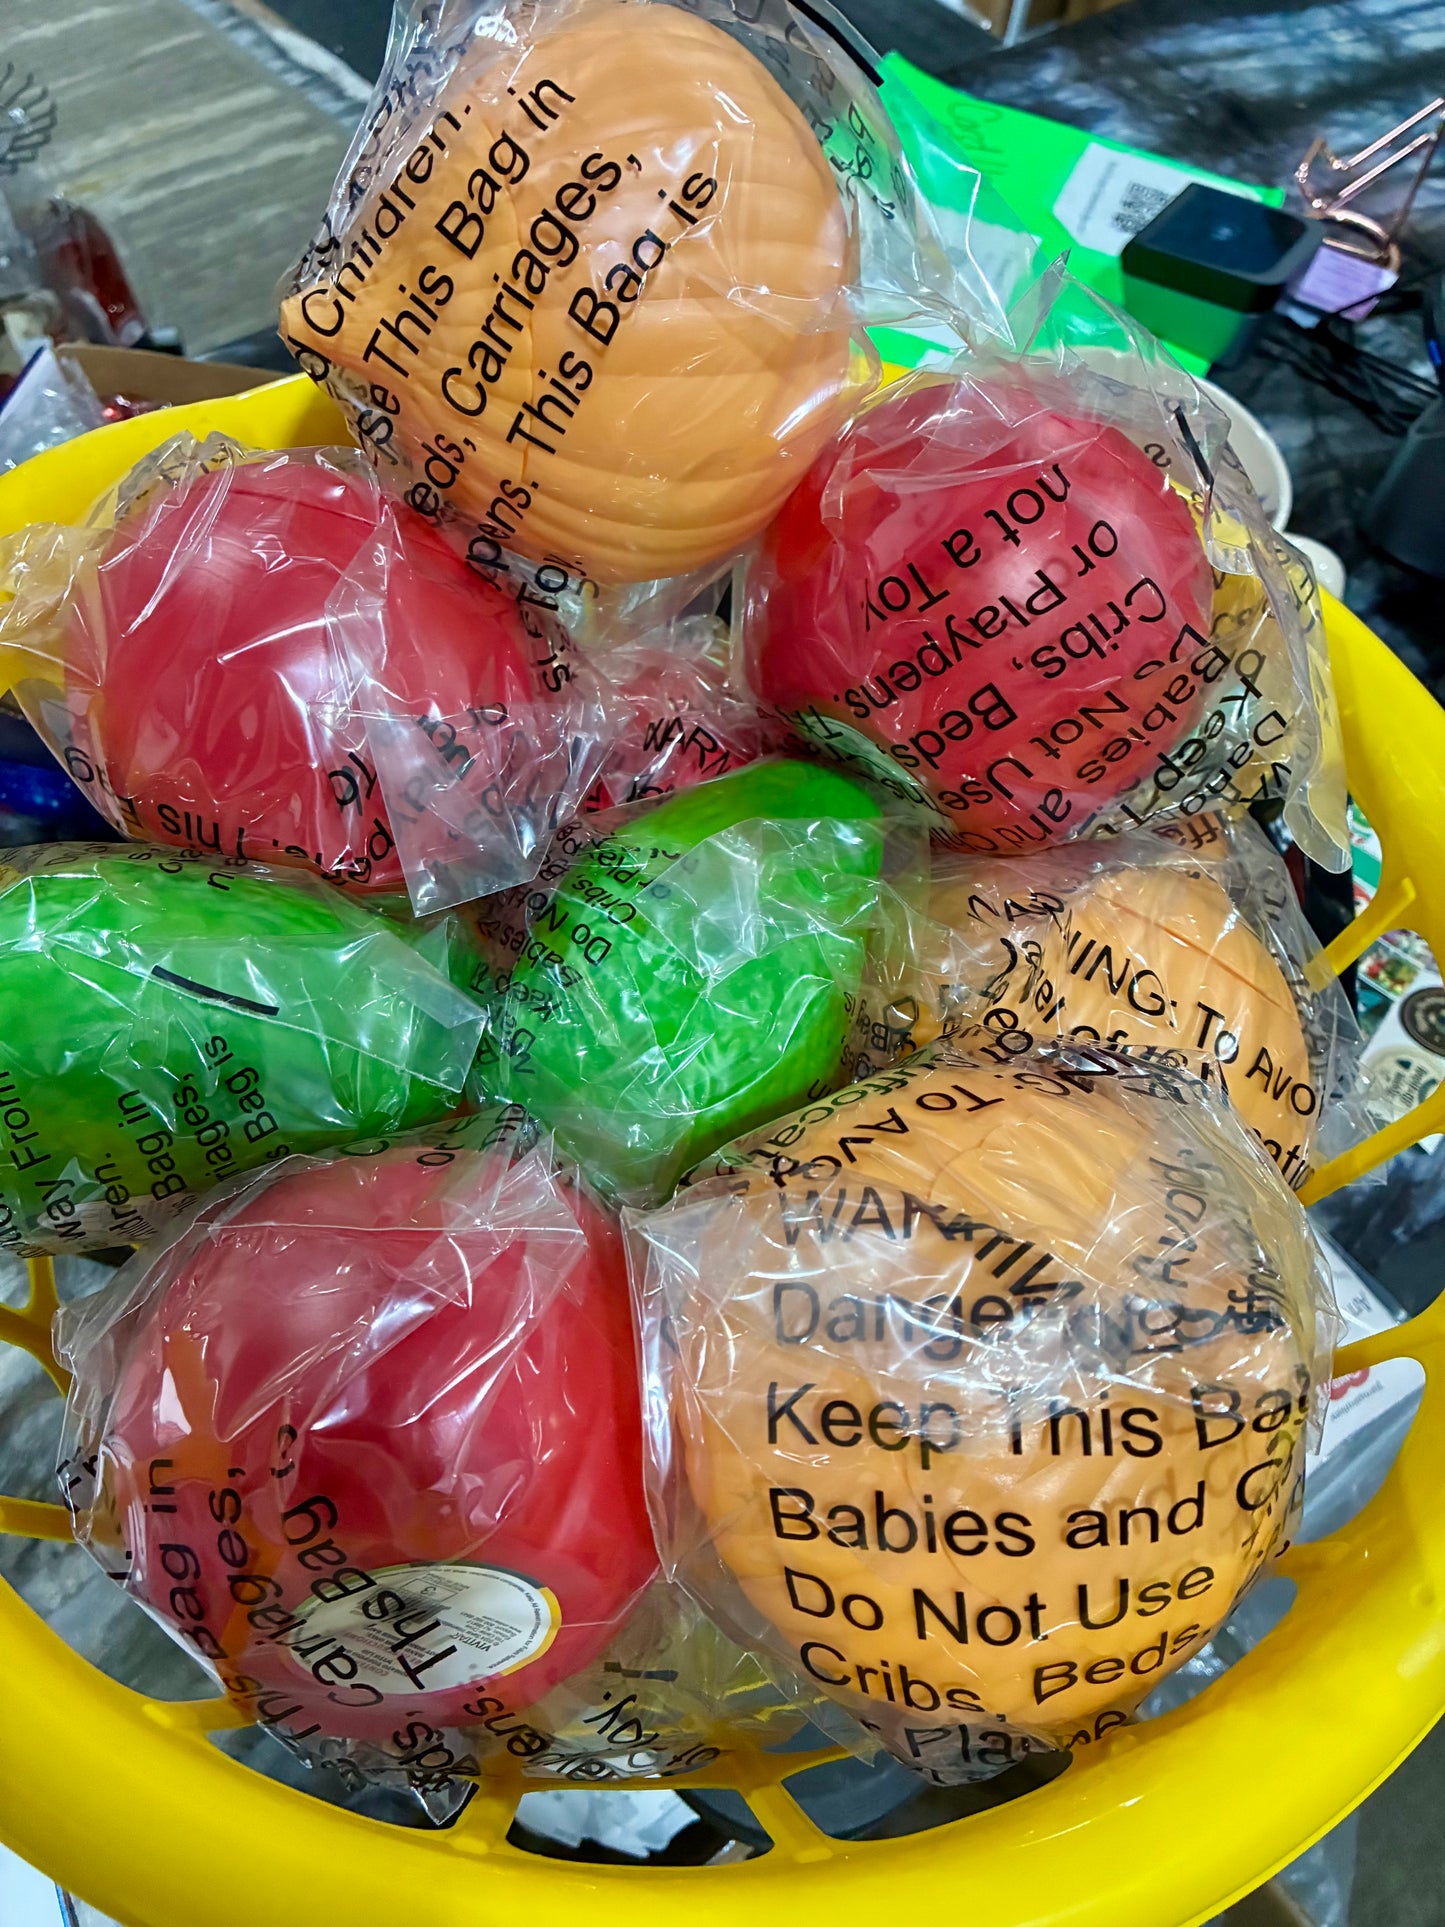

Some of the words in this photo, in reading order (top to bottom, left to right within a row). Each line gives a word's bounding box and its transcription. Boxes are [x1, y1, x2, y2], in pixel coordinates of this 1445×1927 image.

[363, 266, 454, 378] This
[435, 130, 530, 260] Bag
[507, 79, 576, 132] in
[442, 151, 643, 417] Carriages,
[506, 349, 593, 455] This
[568, 228, 672, 345] Bag
[659, 172, 719, 227] is
[408, 434, 477, 517] eds,
[985, 464, 1072, 548] not
[941, 527, 982, 570] a
[1071, 519, 1119, 581] or
[832, 569, 1068, 720] Playpens.
[1011, 577, 1168, 679] Cribs,
[876, 682, 1018, 771] Beds,
[1030, 690, 1131, 759] Not
[1077, 646, 1231, 784] Babies
[1154, 676, 1264, 792] Keep
[938, 755, 1035, 811] Use
[992, 790, 1072, 851] and
[572, 874, 637, 925] Cribs,
[571, 923, 613, 967] Do
[204, 1035, 234, 1072] is
[1196, 1001, 1241, 1065] To
[118, 1089, 152, 1129] in
[224, 1066, 280, 1144] Bag
[915, 1083, 1006, 1113] To
[136, 1131, 189, 1201] Bag
[766, 1381, 962, 1471] Keep
[143, 1459, 177, 1513] in
[769, 1488, 1036, 1558] Babies
[1065, 1480, 1206, 1550] and
[208, 1467, 384, 1710] Carriages,
[281, 1495, 378, 1604] Bag
[159, 1543, 229, 1660] Bag
[362, 1590, 458, 1691] This
[784, 1565, 884, 1632] Do
[913, 1587, 1050, 1647] Not
[1077, 1565, 1215, 1631] Use
